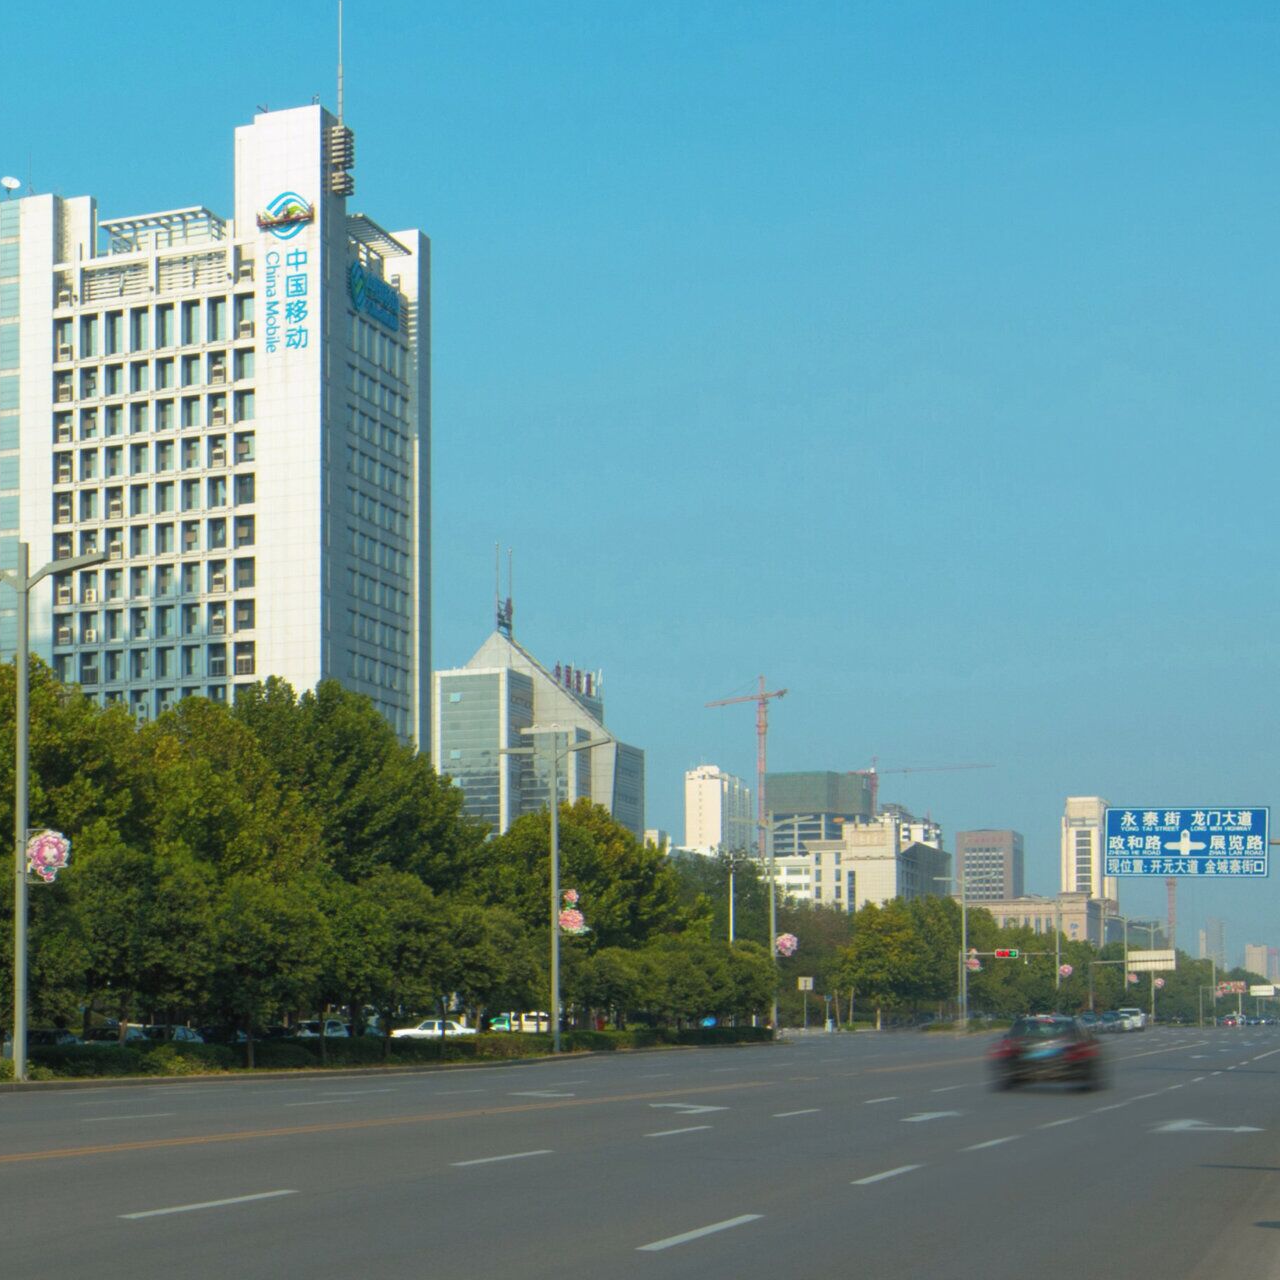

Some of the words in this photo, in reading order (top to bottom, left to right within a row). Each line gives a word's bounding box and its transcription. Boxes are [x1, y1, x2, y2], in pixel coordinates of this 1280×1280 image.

[266, 251, 280, 297] China
[285, 248, 309, 349] 中国移动
[266, 301, 280, 353] Mobile
[1121, 811, 1181, 826] 永泰街
[1191, 811, 1253, 826] 龙门大道
[1108, 835, 1162, 851] 政和路
[1209, 835, 1264, 851] 展览路
